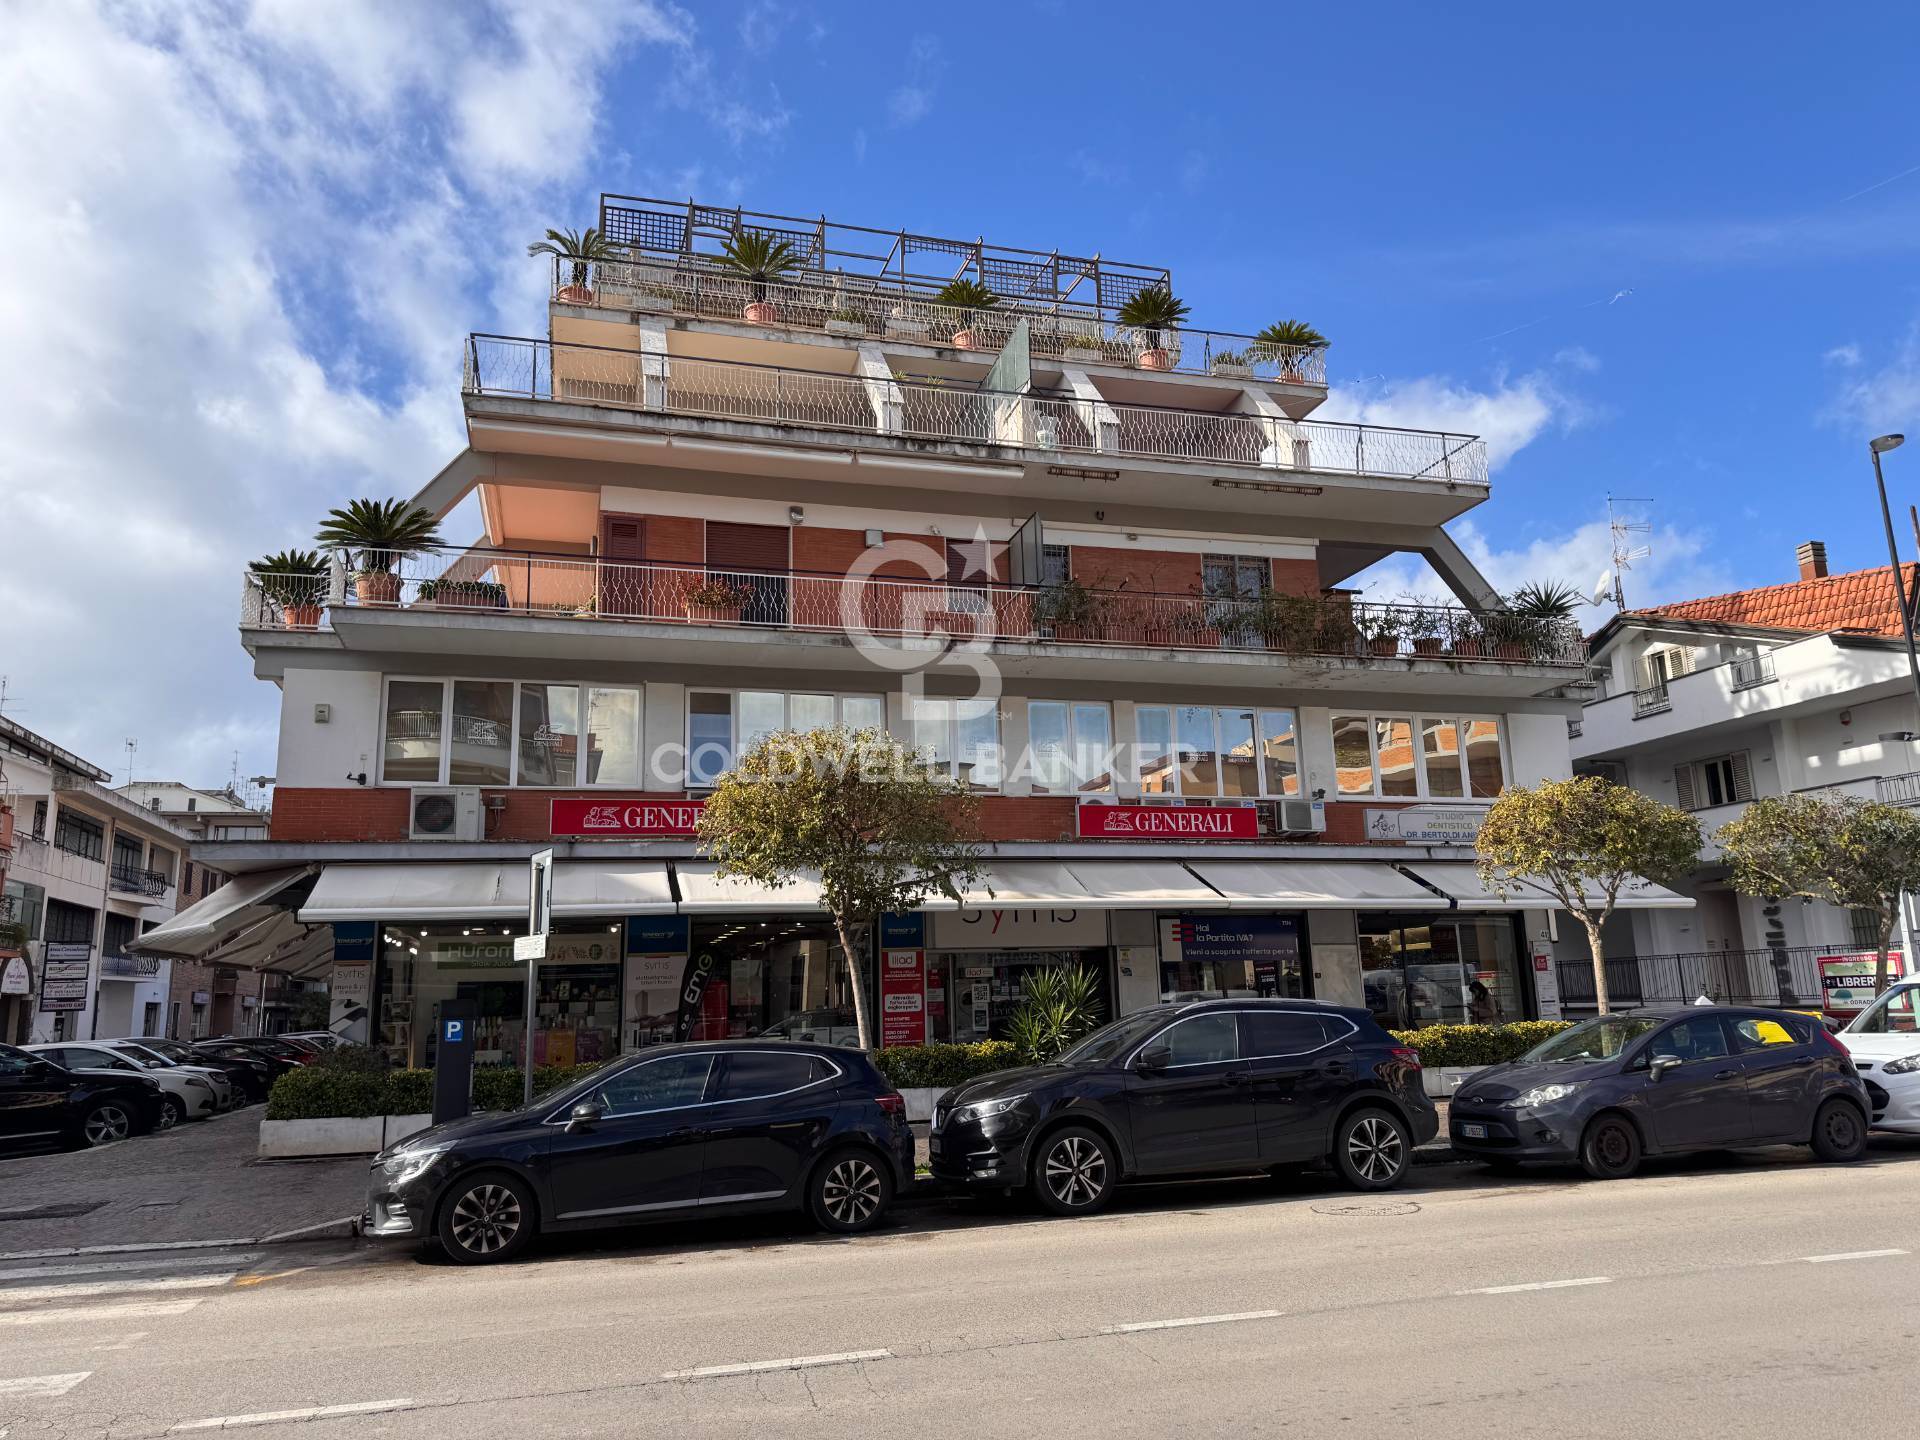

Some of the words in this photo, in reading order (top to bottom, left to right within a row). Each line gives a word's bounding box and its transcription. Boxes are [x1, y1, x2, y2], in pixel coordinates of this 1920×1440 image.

[1135, 813, 1234, 833] GENERALI
[1195, 924, 1210, 932] Hai
[1206, 934, 1236, 942] Partita
[1211, 948, 1241, 957] scoprire
[891, 954, 913, 965] iliad
[447, 1021, 461, 1038] P
